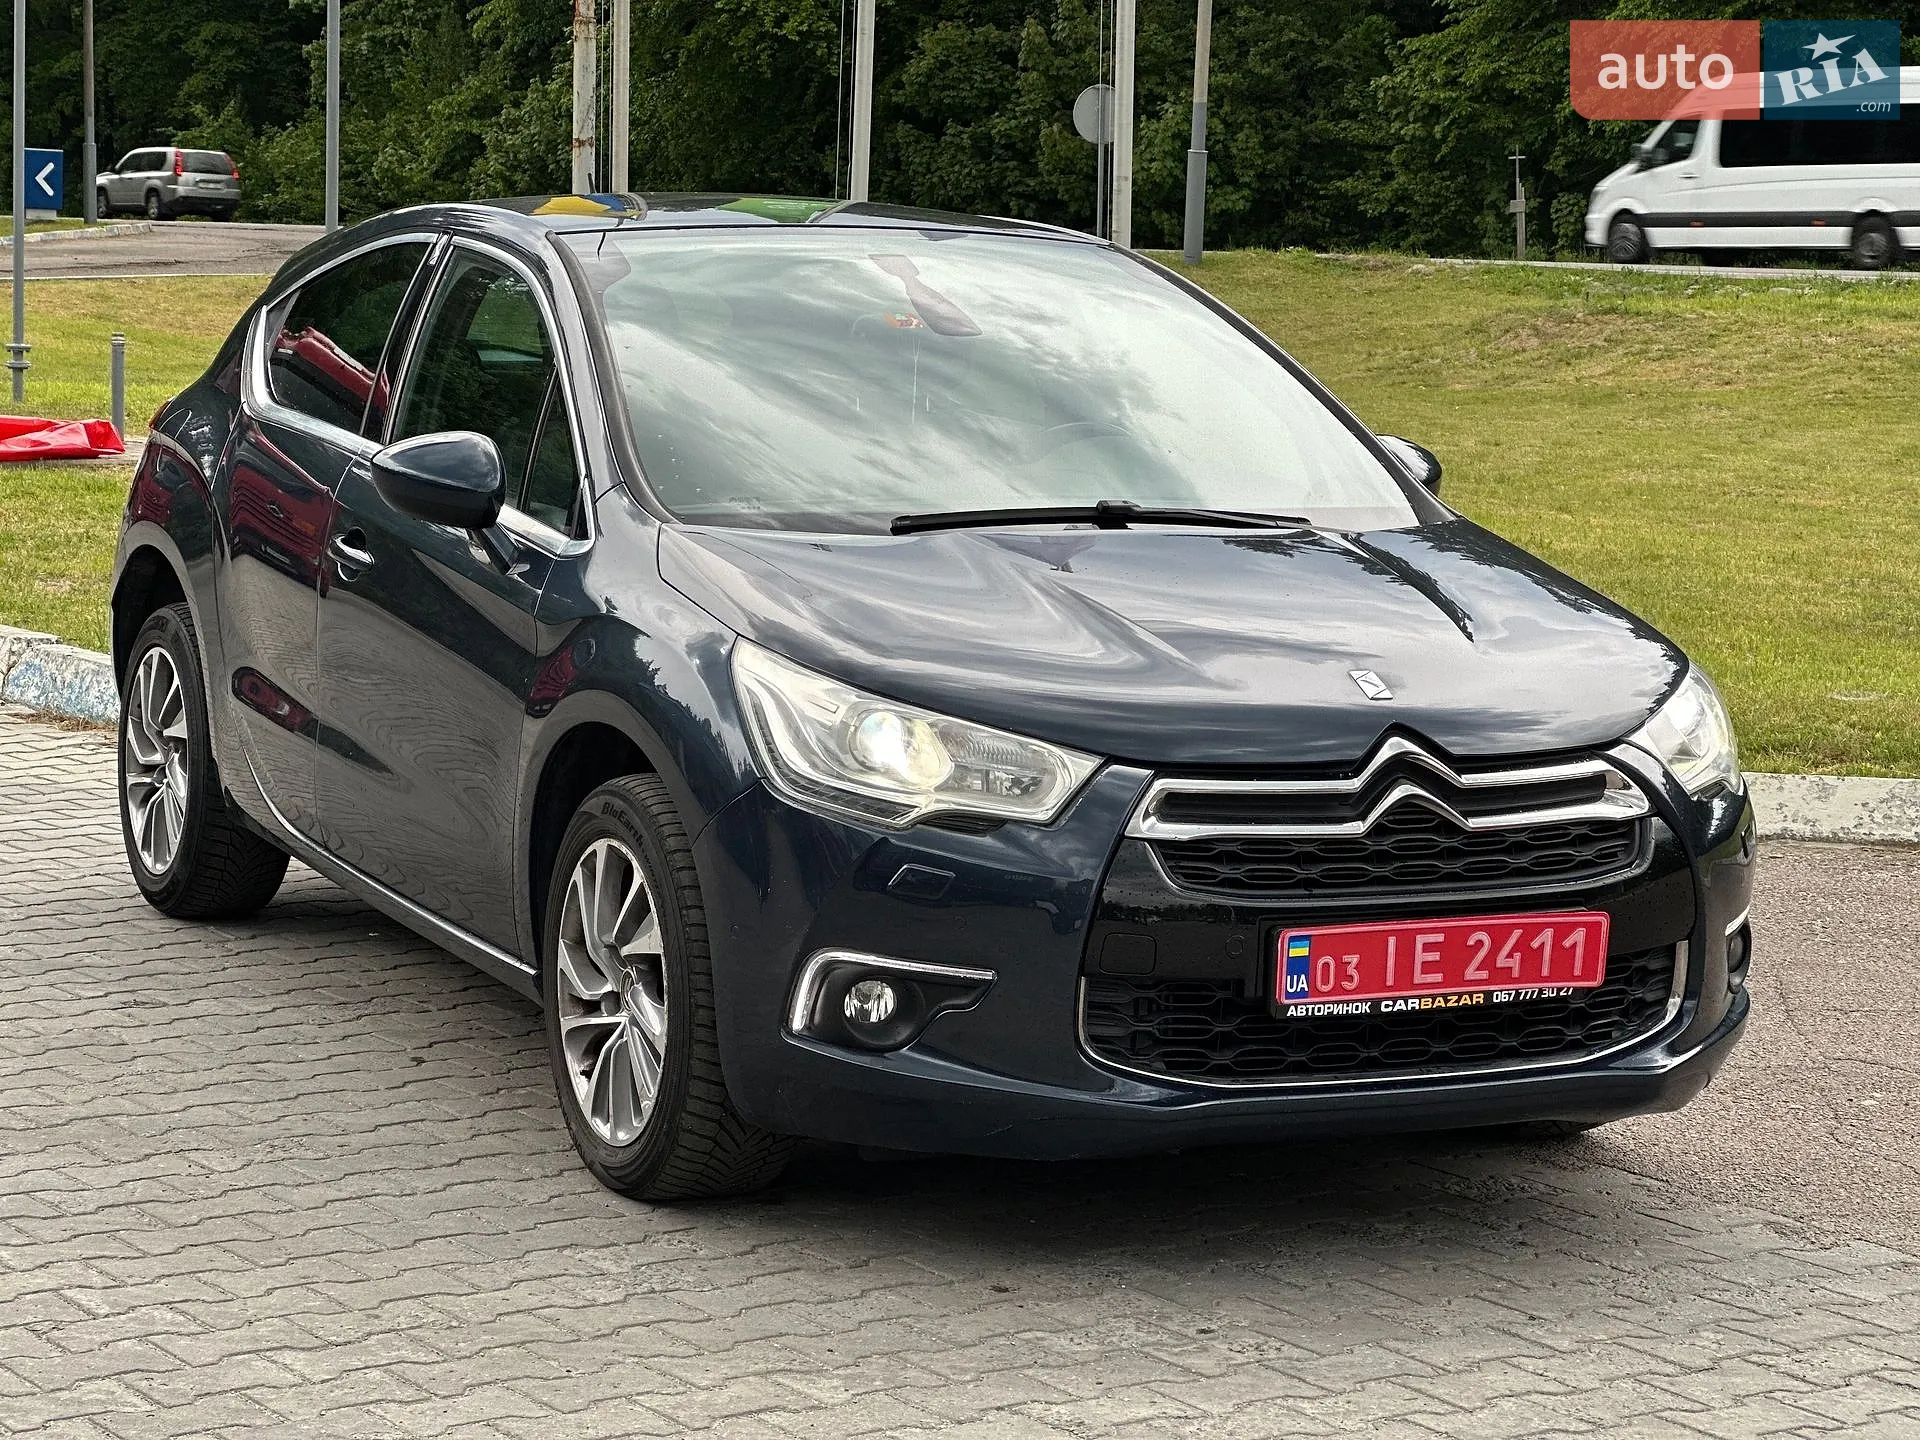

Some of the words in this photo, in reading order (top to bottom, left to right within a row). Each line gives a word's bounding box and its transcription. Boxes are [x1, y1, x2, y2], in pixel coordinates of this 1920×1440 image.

[1316, 954, 1361, 993] 03
[1385, 932, 1446, 987] IE
[1463, 927, 1588, 982] 2411
[1286, 973, 1309, 993] UA
[1286, 1001, 1372, 1017] АВТОРИНОК
[1380, 993, 1484, 1013] CARBAZAR
[1492, 989, 1515, 1003] 067
[1518, 988, 1539, 1001] 777
